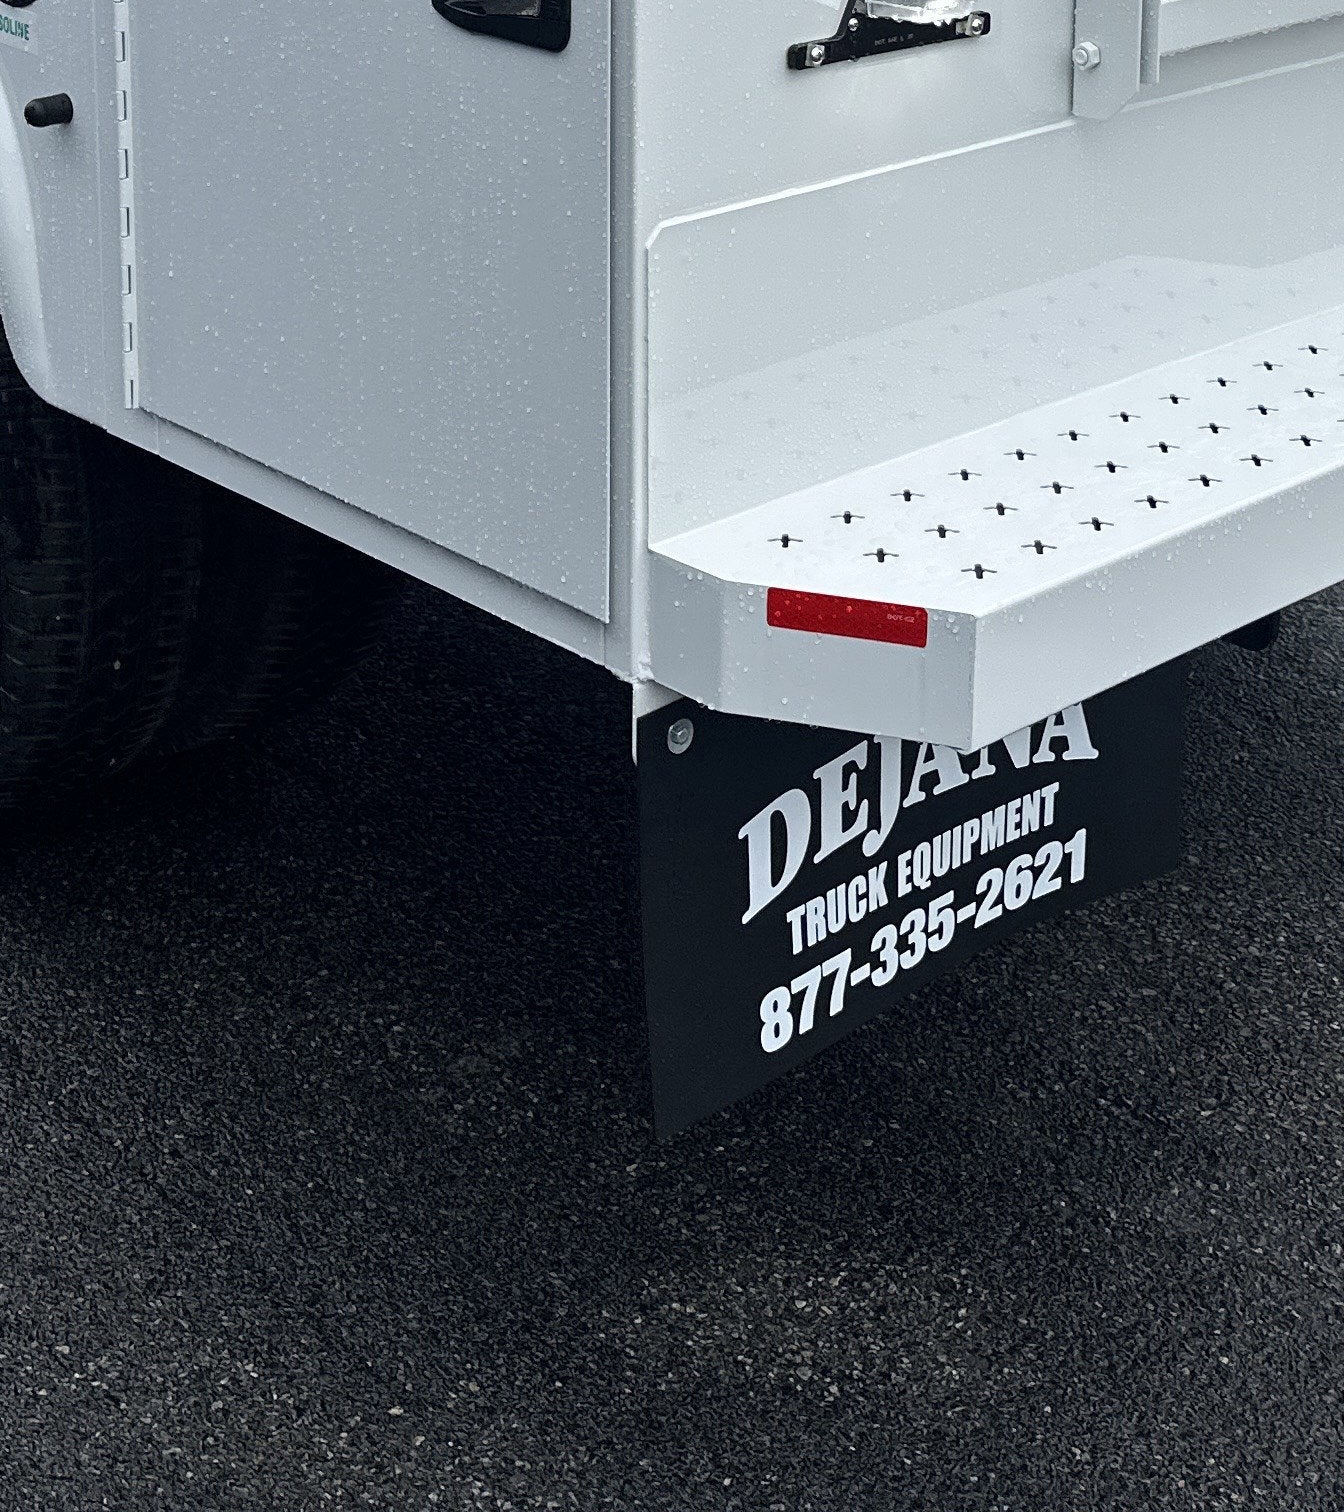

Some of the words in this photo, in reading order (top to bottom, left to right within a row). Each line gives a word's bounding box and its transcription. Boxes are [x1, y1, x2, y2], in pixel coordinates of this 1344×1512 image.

[760, 828, 1087, 1053] 877-335-2621
[786, 861, 889, 955] TRUCK
[897, 782, 1060, 898] EQUIPMENT
